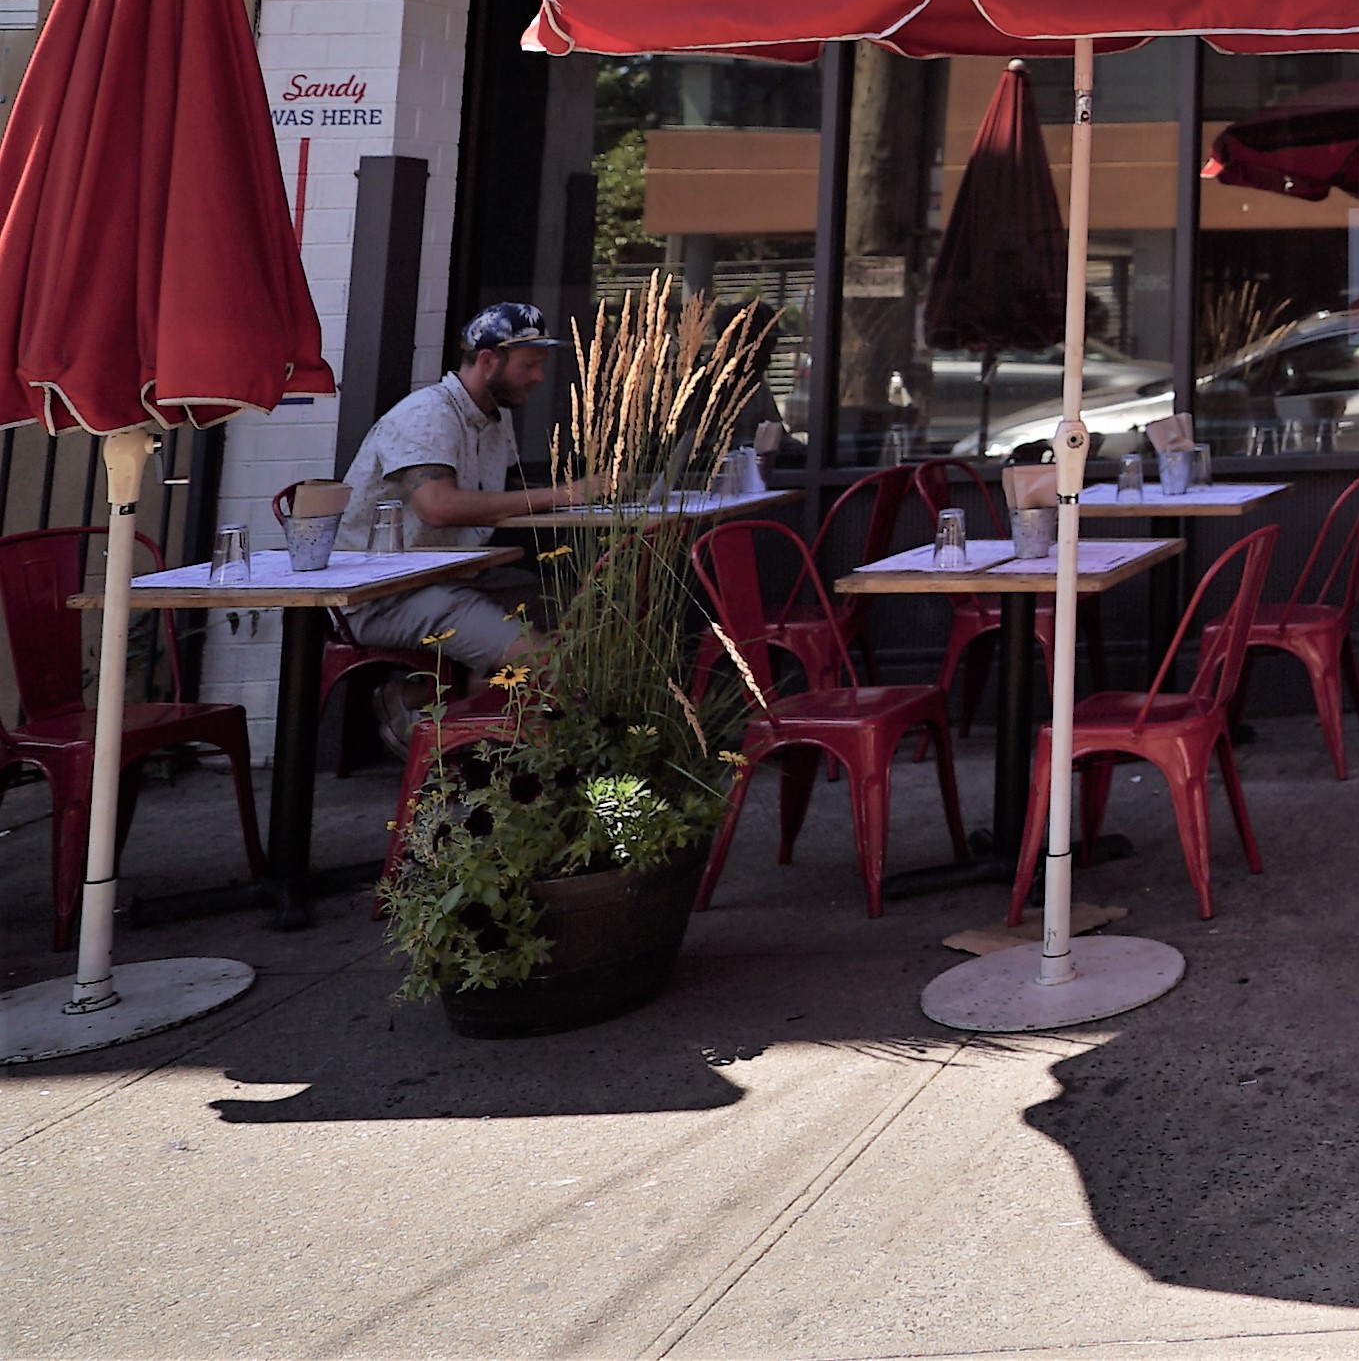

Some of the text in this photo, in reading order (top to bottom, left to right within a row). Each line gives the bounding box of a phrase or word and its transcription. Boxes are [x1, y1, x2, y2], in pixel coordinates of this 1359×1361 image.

[282, 74, 367, 104] Sandy
[271, 109, 382, 126] WAS HERE
